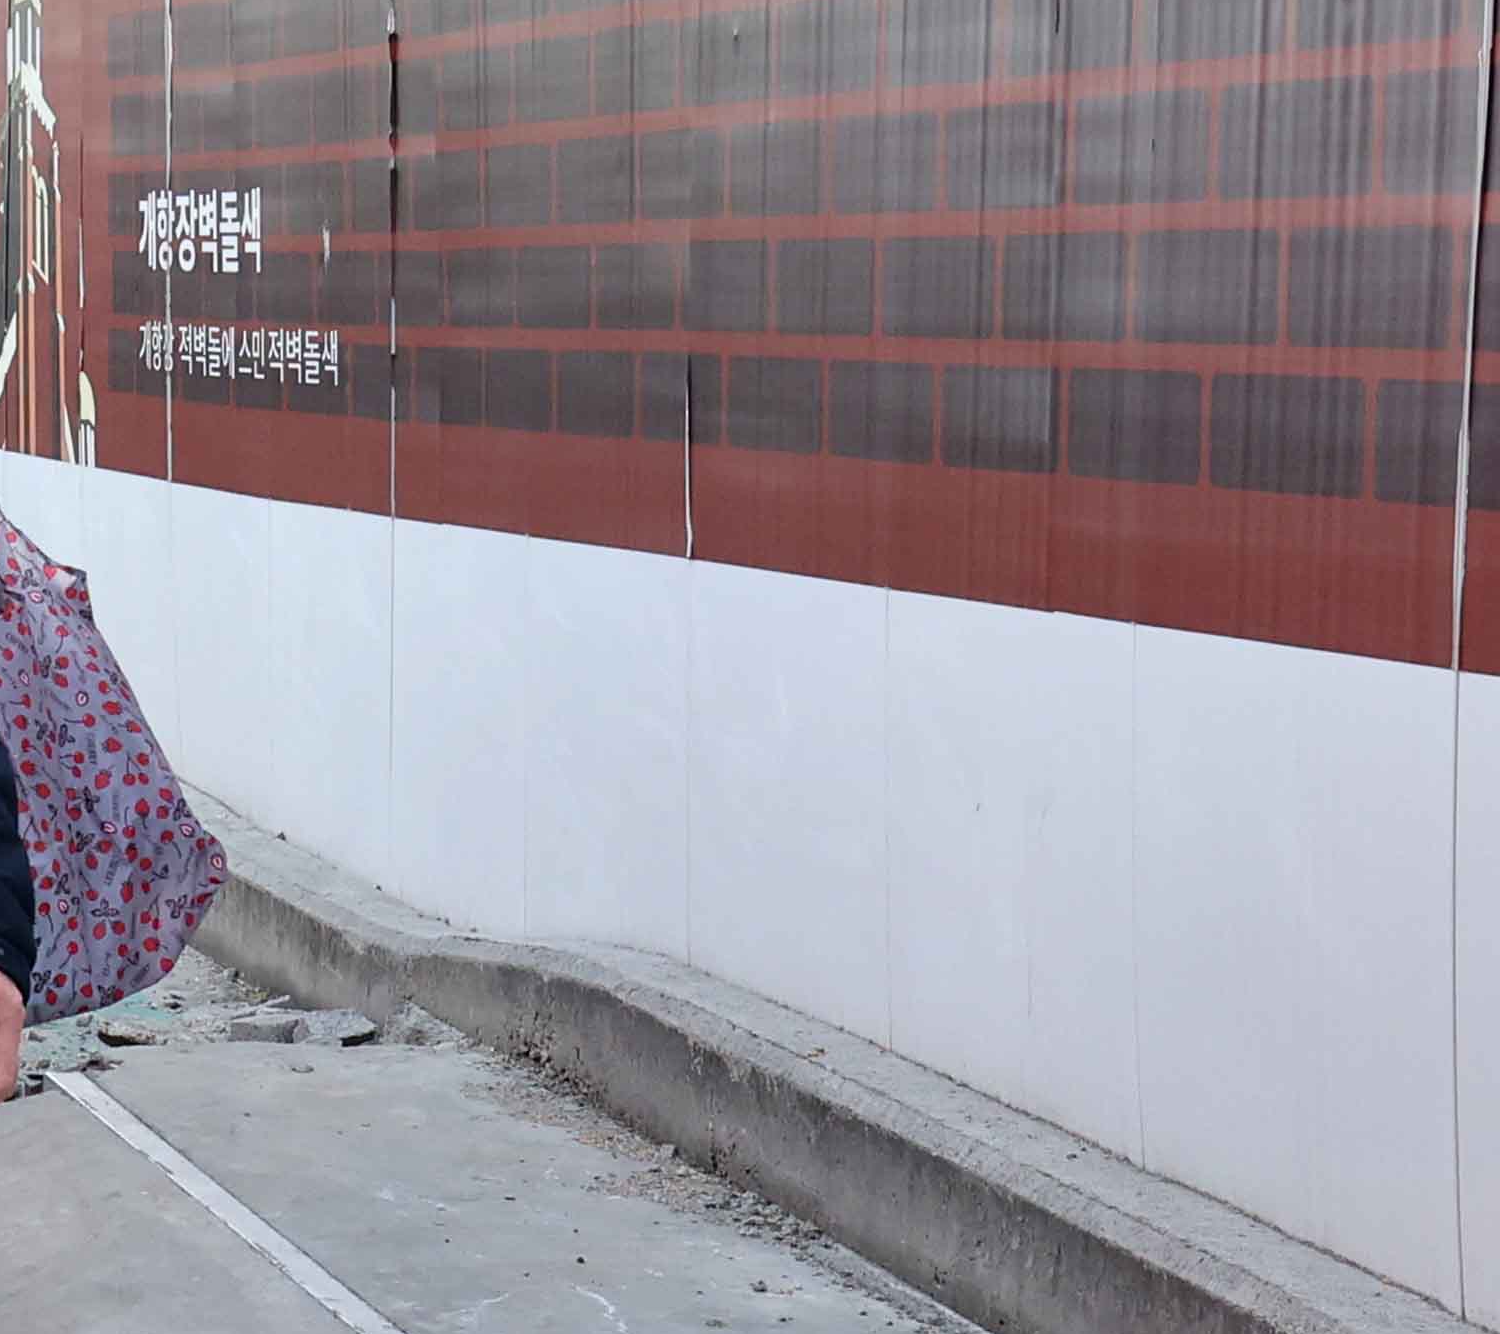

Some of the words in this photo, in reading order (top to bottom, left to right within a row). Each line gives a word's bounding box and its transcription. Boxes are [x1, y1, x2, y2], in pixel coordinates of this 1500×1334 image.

[178, 323, 235, 380] 적벽돌에
[238, 328, 265, 380] 스민
[268, 328, 338, 386] 적벽돌색
